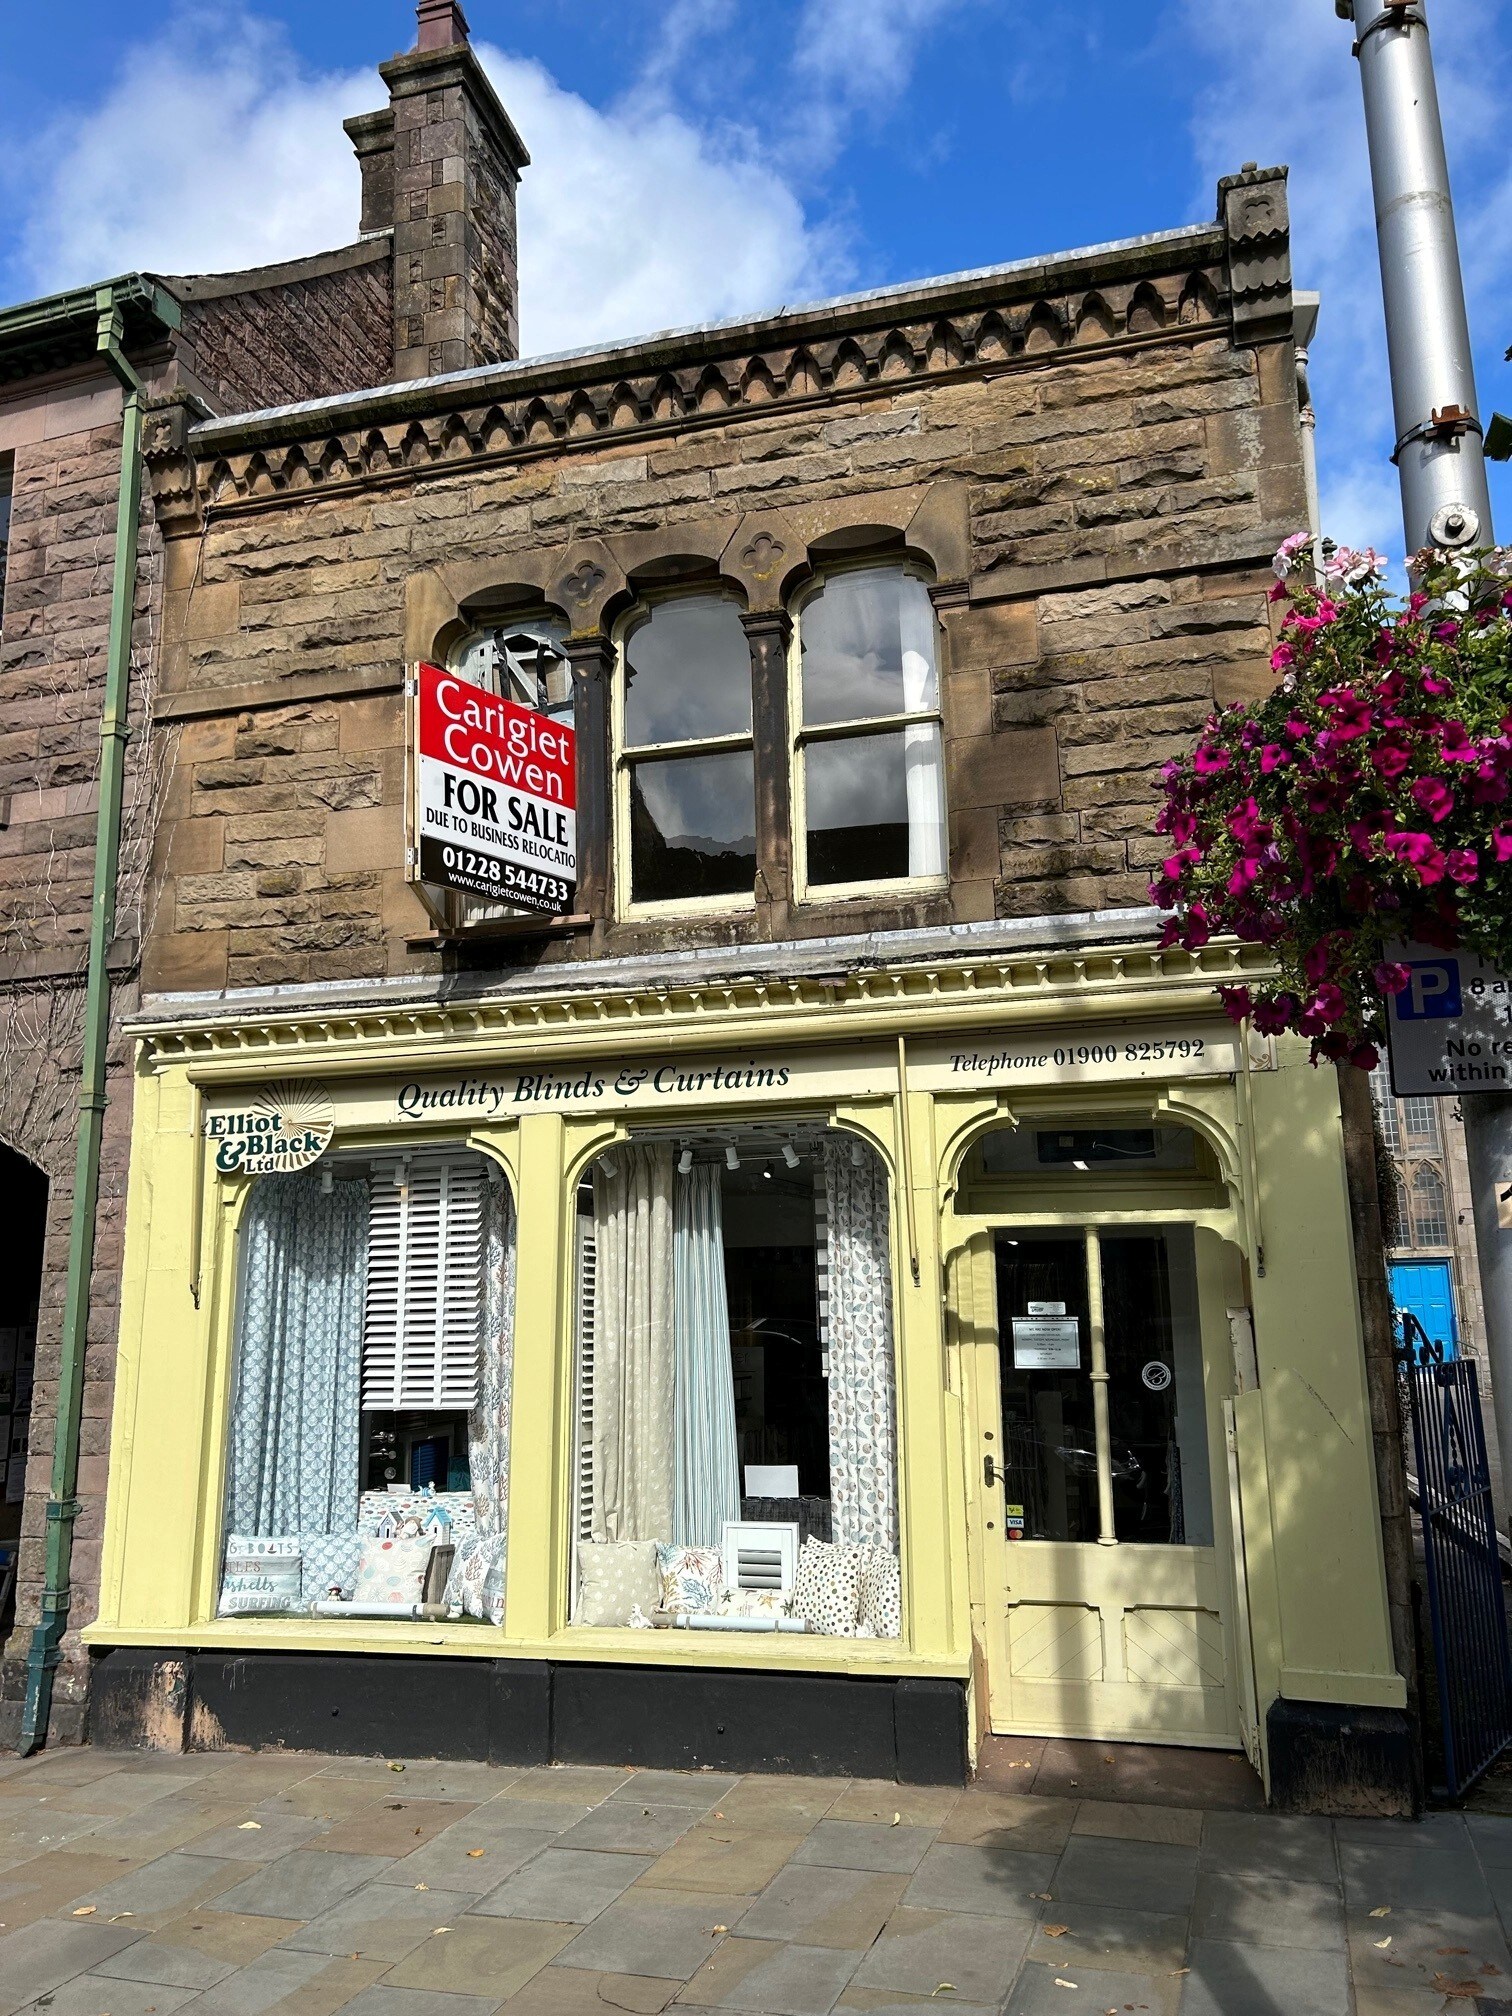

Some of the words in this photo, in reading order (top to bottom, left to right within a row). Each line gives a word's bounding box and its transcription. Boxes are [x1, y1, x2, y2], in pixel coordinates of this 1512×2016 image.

[436, 679, 570, 766] Carigiet
[444, 723, 564, 801] Cowen
[443, 772, 500, 824] FOR
[508, 796, 569, 848] SALE
[426, 807, 450, 828] DUE
[452, 815, 468, 833] TO
[471, 822, 519, 850] BUSINESS
[522, 838, 576, 868] RELOCATIO
[442, 847, 500, 882] 01228
[505, 864, 568, 901] 544733
[448, 872, 563, 913] www.carigietcowen.co.uk
[1410, 966, 1450, 1014] P
[1471, 977, 1485, 995] 8
[950, 1052, 1048, 1077] Telephone
[1053, 1044, 1118, 1067] 01900
[1125, 1038, 1205, 1061] 825792
[1446, 1039, 1482, 1057] No
[398, 1079, 504, 1119] Quality
[511, 1071, 606, 1103] Blinds
[614, 1068, 649, 1096] &
[653, 1060, 790, 1093] Curtains
[1428, 1062, 1506, 1082] within
[209, 1113, 283, 1136] Elliot
[216, 1140, 247, 1170] &
[246, 1131, 323, 1156] Black
[245, 1157, 275, 1173] Ltd
[229, 1596, 291, 1610] SURFING
